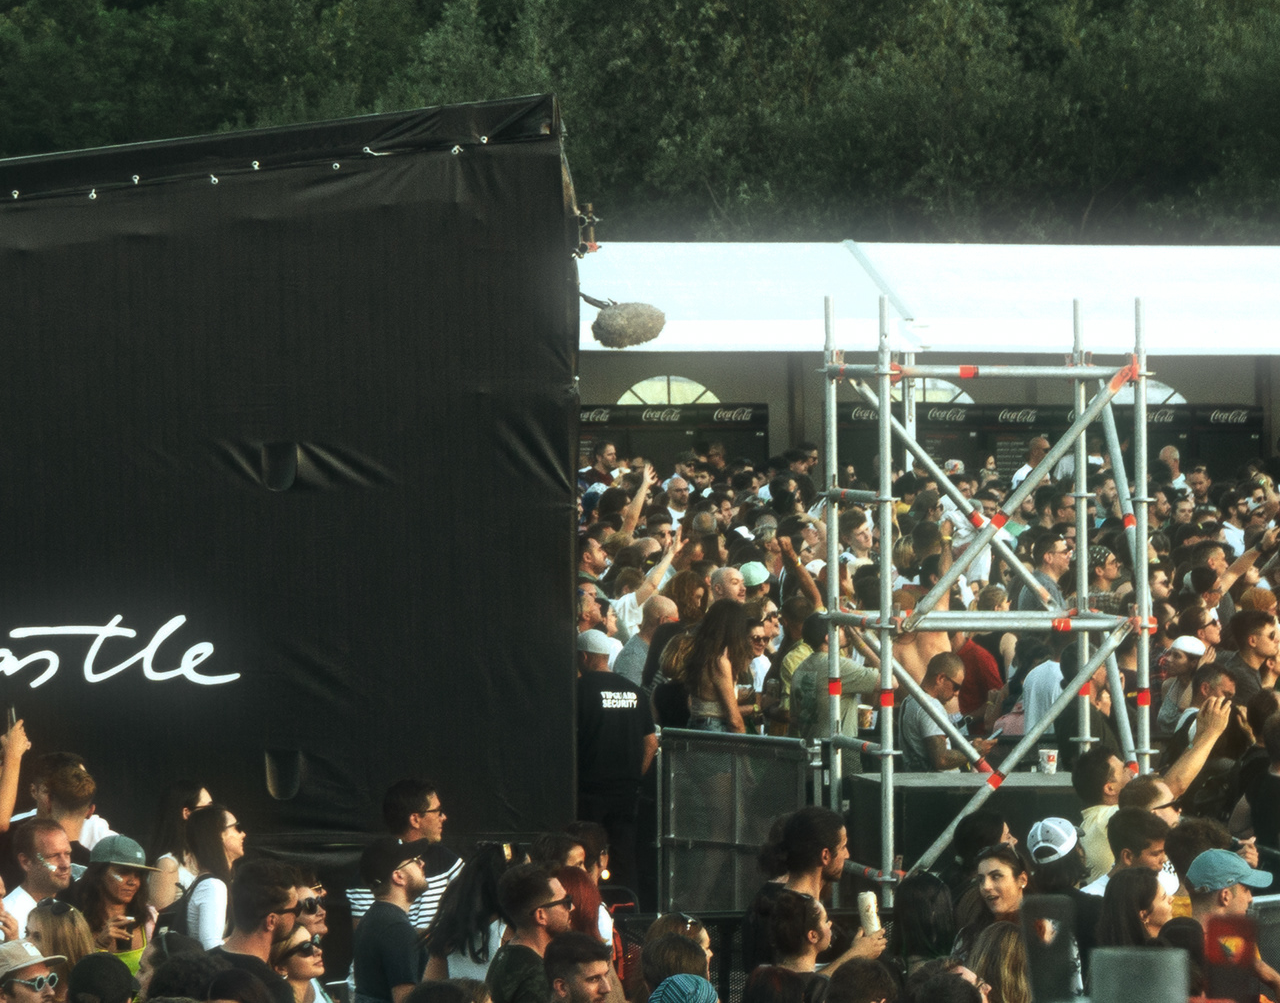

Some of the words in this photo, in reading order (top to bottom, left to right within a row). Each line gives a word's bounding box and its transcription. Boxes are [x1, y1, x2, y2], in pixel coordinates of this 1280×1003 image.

[641, 407, 682, 422] Coca-Cola
[713, 407, 753, 422] Coca-Cola
[927, 407, 967, 422] Coca-Cola
[998, 408, 1038, 423] Coca-Cola
[1210, 409, 1248, 423] Coca-Cola
[602, 699, 638, 708] SECURITY
